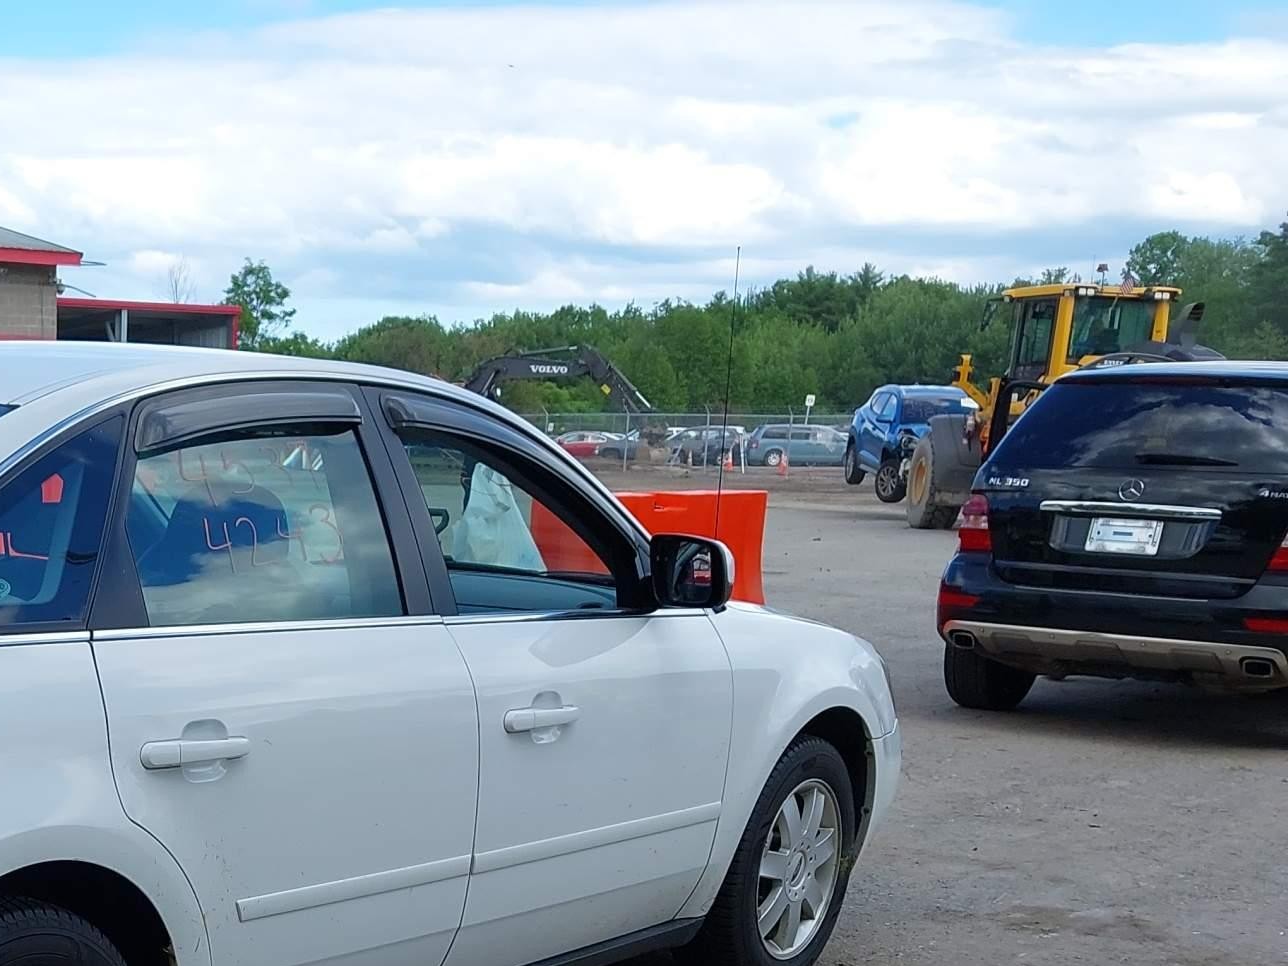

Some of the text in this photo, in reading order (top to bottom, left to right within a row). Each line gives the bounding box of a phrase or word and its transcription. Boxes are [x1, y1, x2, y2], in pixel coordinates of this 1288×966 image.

[529, 364, 568, 374] VOLVO
[1004, 477, 1030, 487] 350
[203, 503, 345, 575] 4243
